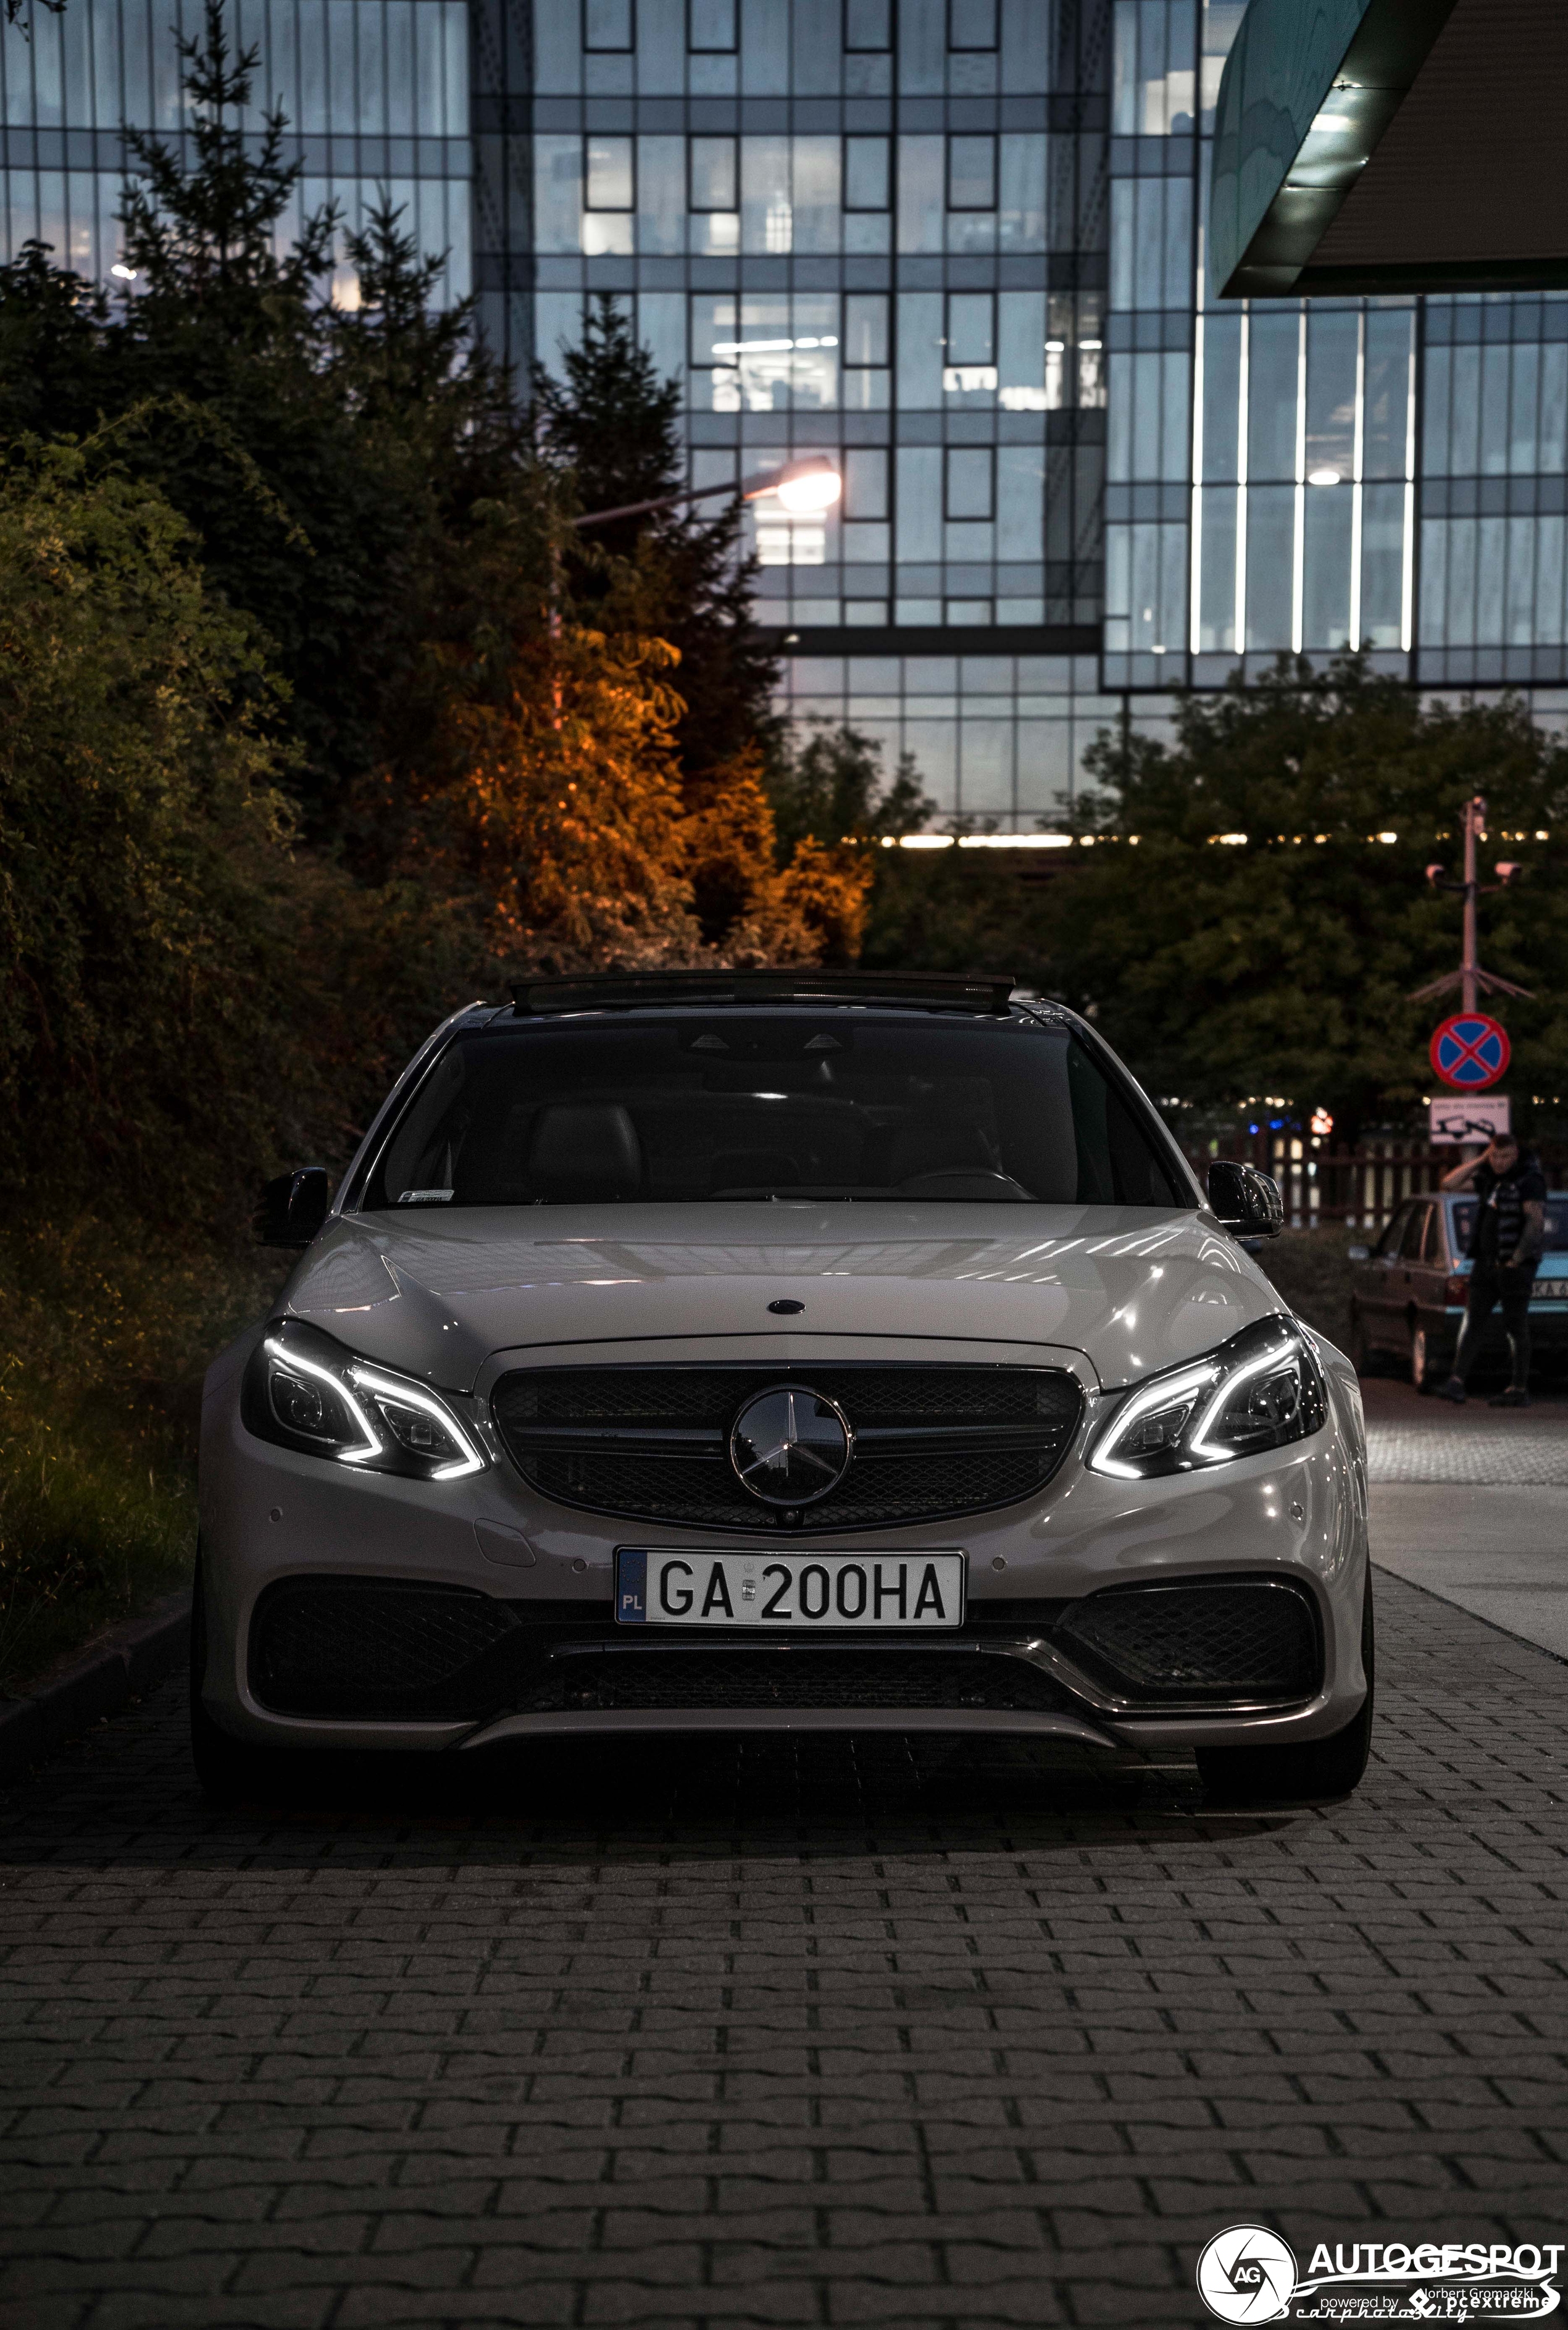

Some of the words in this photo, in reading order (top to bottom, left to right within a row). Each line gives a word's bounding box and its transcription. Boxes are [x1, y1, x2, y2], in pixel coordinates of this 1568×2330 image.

[623, 1595, 643, 1610] PL
[659, 1559, 734, 1618] GA
[761, 1562, 946, 1619] 200HA
